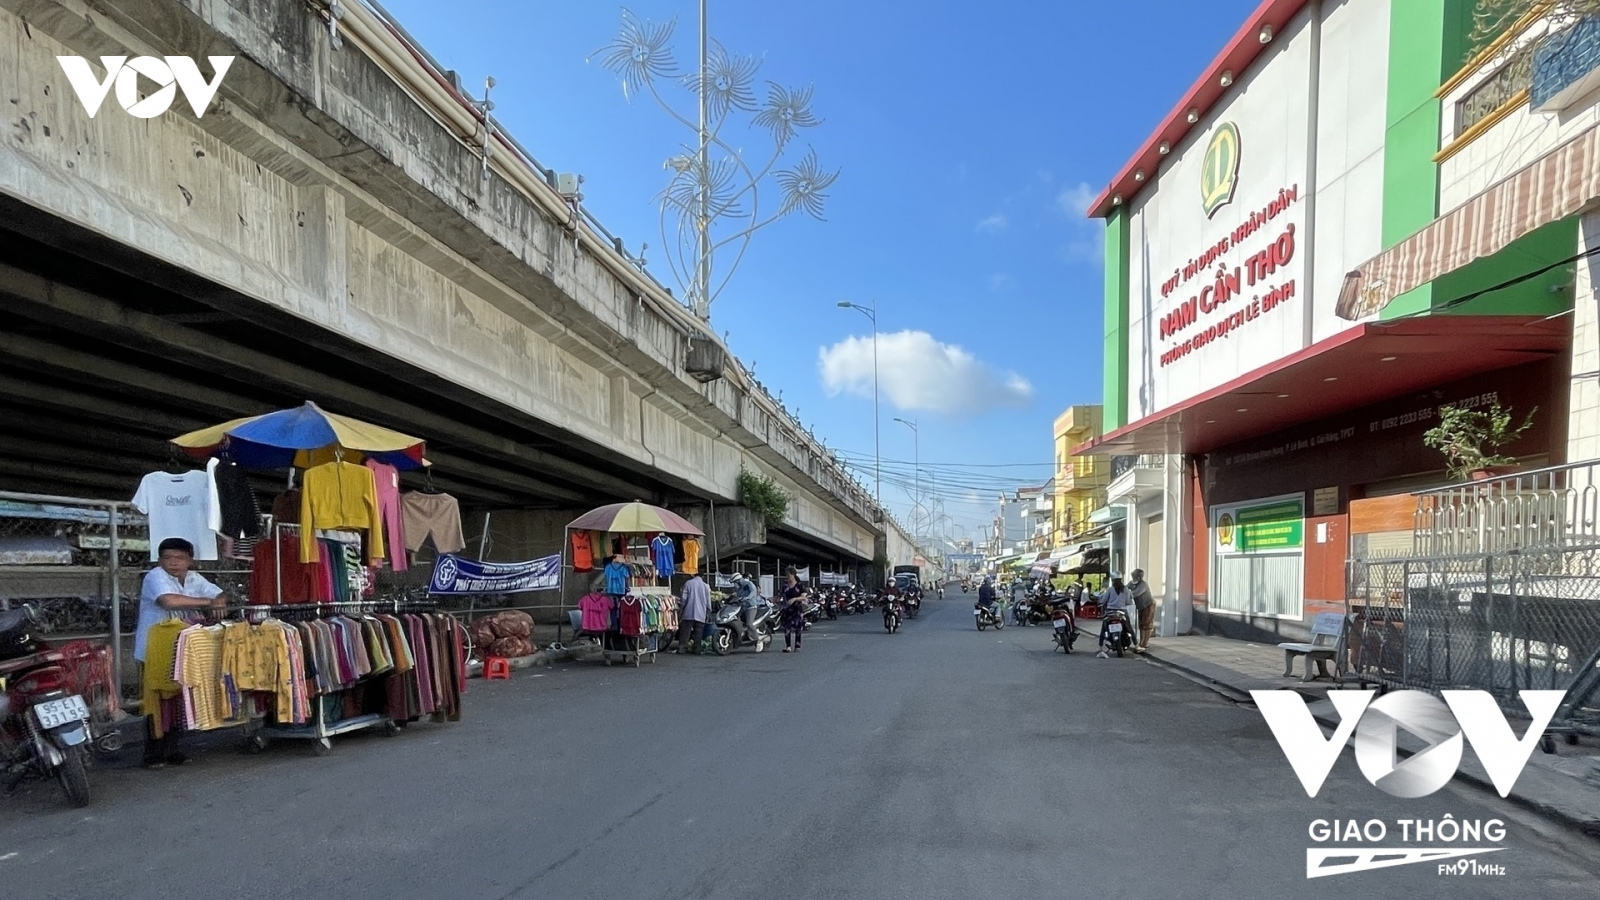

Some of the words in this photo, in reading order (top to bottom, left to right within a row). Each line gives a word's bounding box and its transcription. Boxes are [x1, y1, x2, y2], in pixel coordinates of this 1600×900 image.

[1182, 259, 1198, 282] TÍN
[1199, 237, 1228, 271] DỤNG
[1230, 207, 1266, 248] NHÂN
[1268, 183, 1297, 220] DÂN
[1160, 296, 1197, 341] NAM
[1200, 262, 1240, 314] CẦN
[1244, 223, 1295, 287] THƠ
[1160, 341, 1191, 368] PHÒNG
[1192, 326, 1216, 350] GIAO
[1217, 309, 1244, 339] DỊCH
[1246, 295, 1260, 322] LÊ
[1262, 279, 1295, 313] BÌNH
[1481, 391, 1498, 406] 555
[43, 699, 76, 714] 95-E1
